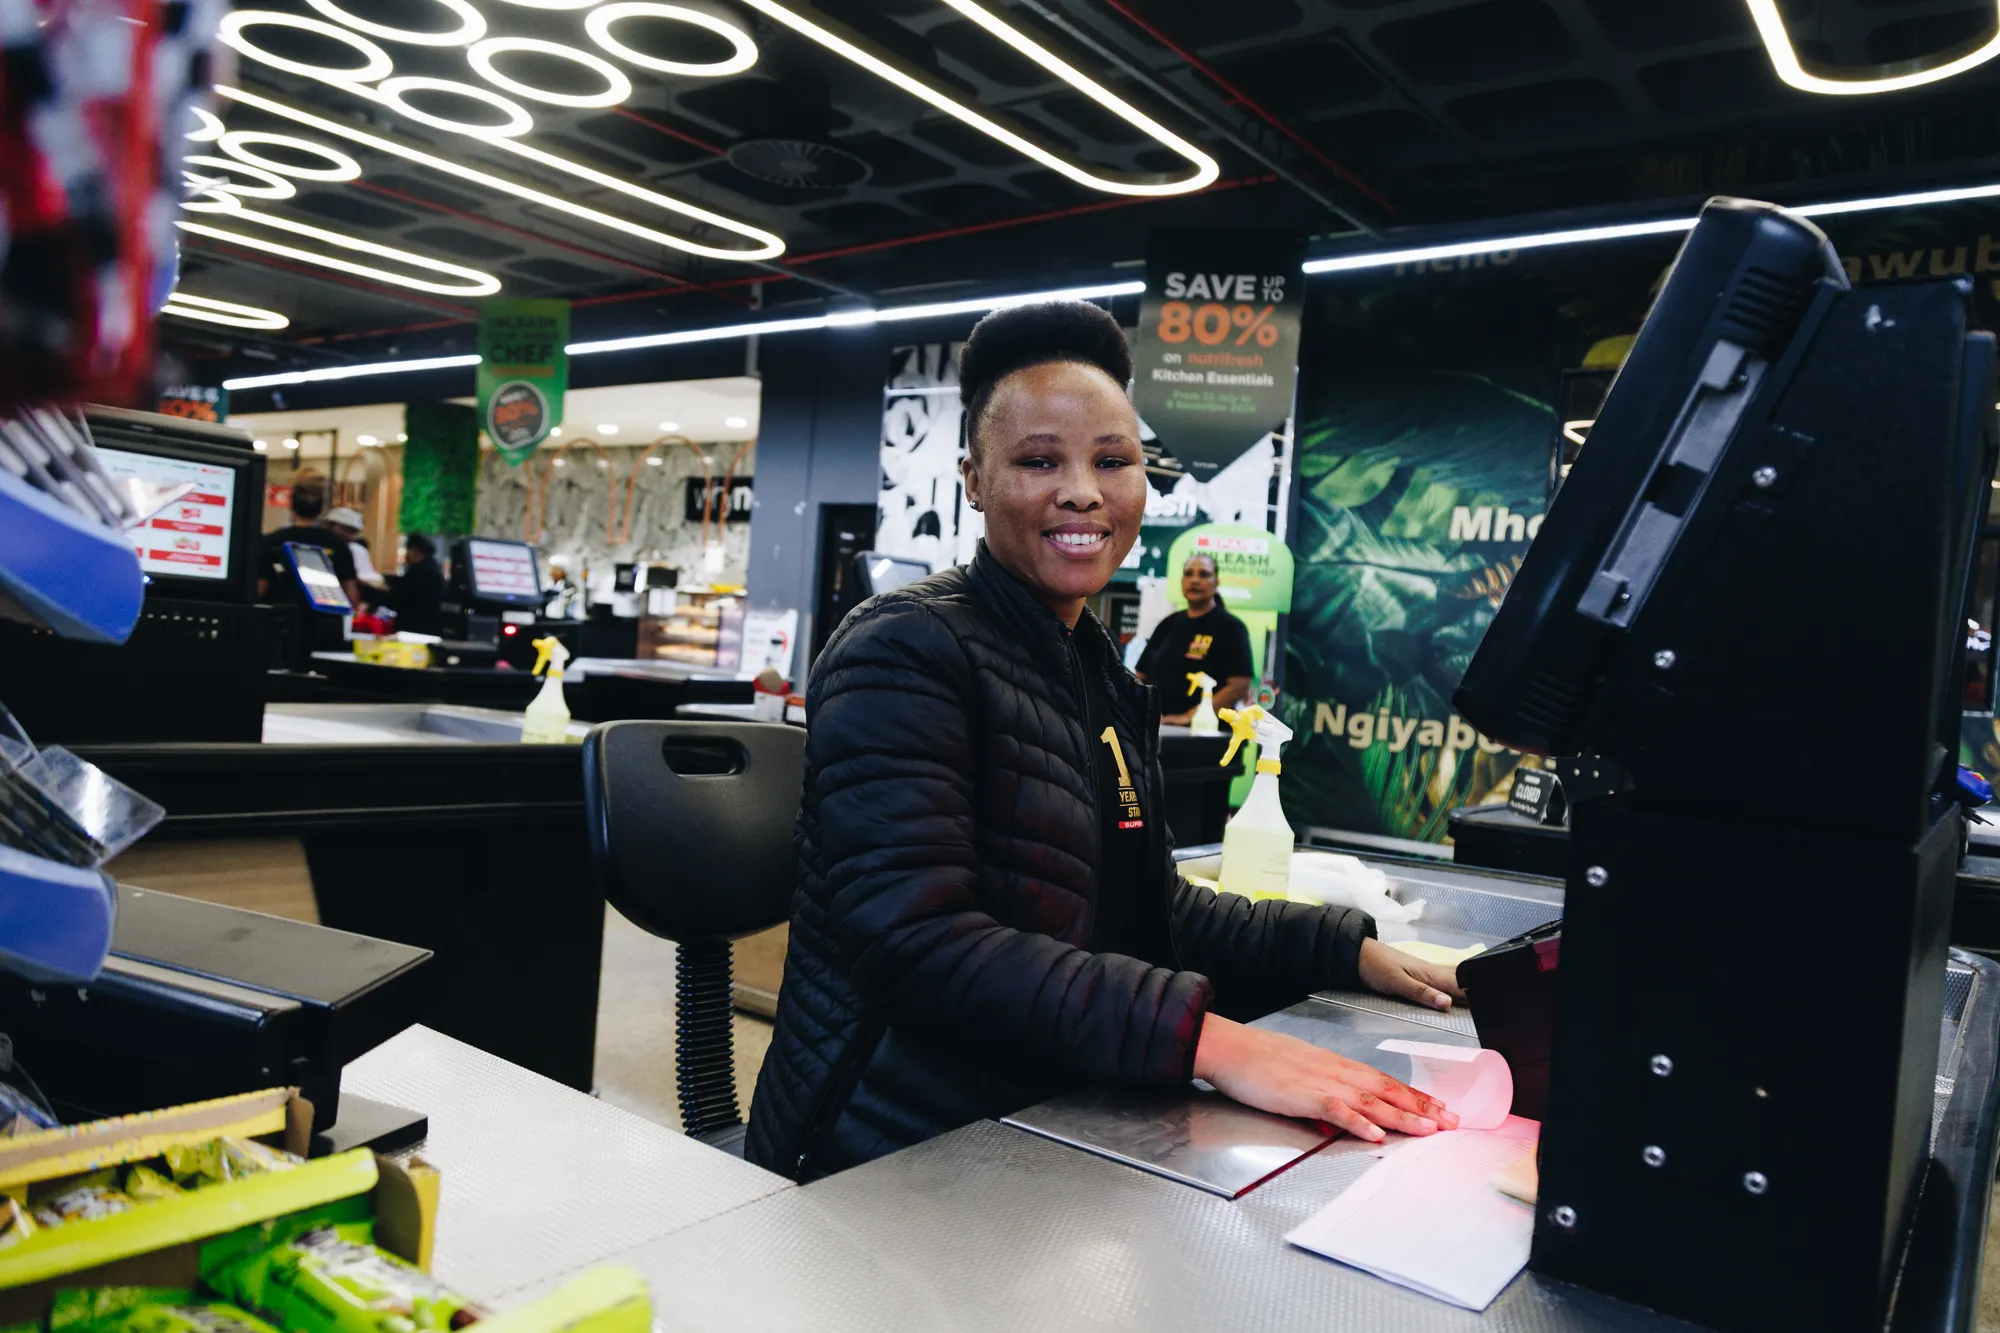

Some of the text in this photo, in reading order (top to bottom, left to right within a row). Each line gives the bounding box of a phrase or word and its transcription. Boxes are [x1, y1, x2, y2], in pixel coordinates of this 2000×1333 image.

[1165, 272, 1256, 300] SAVE
[1263, 276, 1285, 287] UP
[1262, 288, 1284, 302] TO
[1157, 301, 1279, 347] 80%
[1163, 352, 1263, 367] on nutrifresh
[1153, 368, 1274, 386] Kitchen Essentials
[1313, 702, 1521, 757] Ngiyab
[1100, 726, 1132, 786] 1
[1516, 783, 1541, 803] CLOSED
